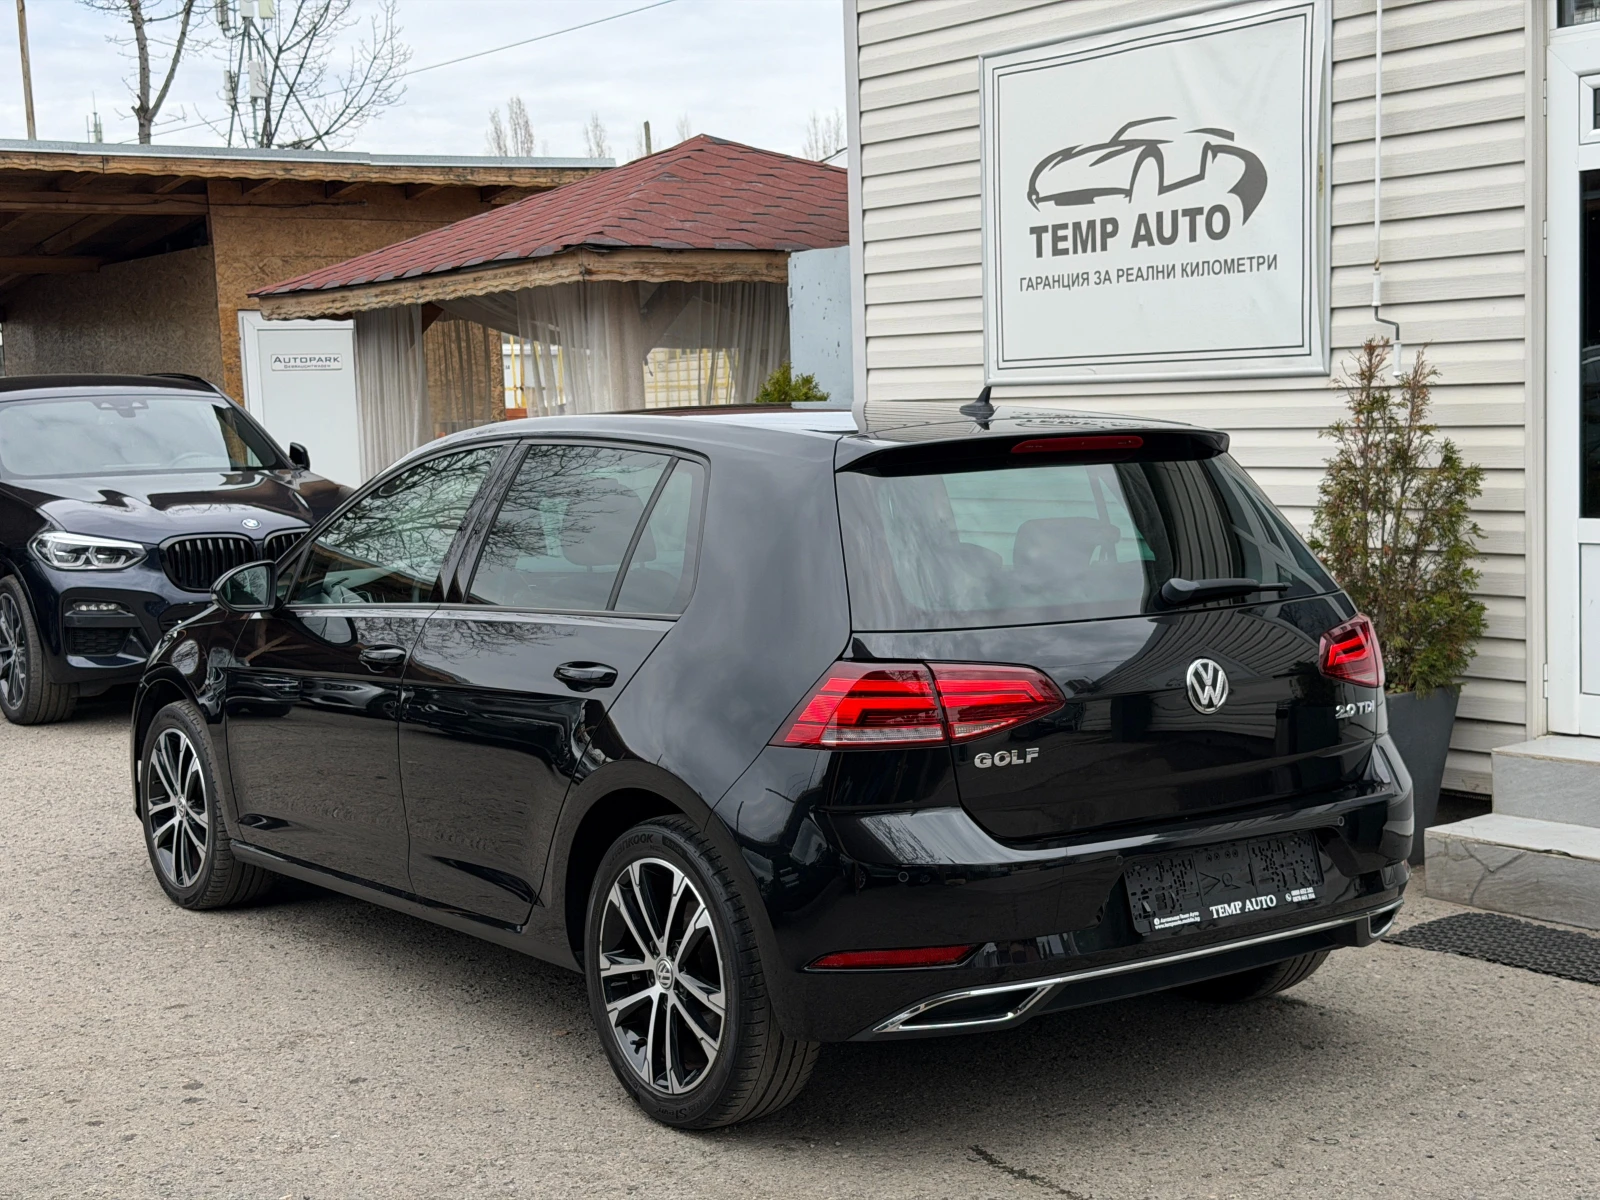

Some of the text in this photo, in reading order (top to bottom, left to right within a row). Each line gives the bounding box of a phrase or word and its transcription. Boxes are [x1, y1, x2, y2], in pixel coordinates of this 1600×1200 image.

[1029, 204, 1231, 259] TEMP AUTO
[1019, 254, 1278, 292] ГАРАНЦИЯ ЗА РЕАЛНИ КИЛОМЕТРИ
[273, 356, 340, 364] AUTOPARK
[1356, 700, 1375, 715] TDI
[974, 747, 1040, 769] GOLF
[1210, 901, 1242, 919] TEMP
[1245, 894, 1277, 912] AUTO
